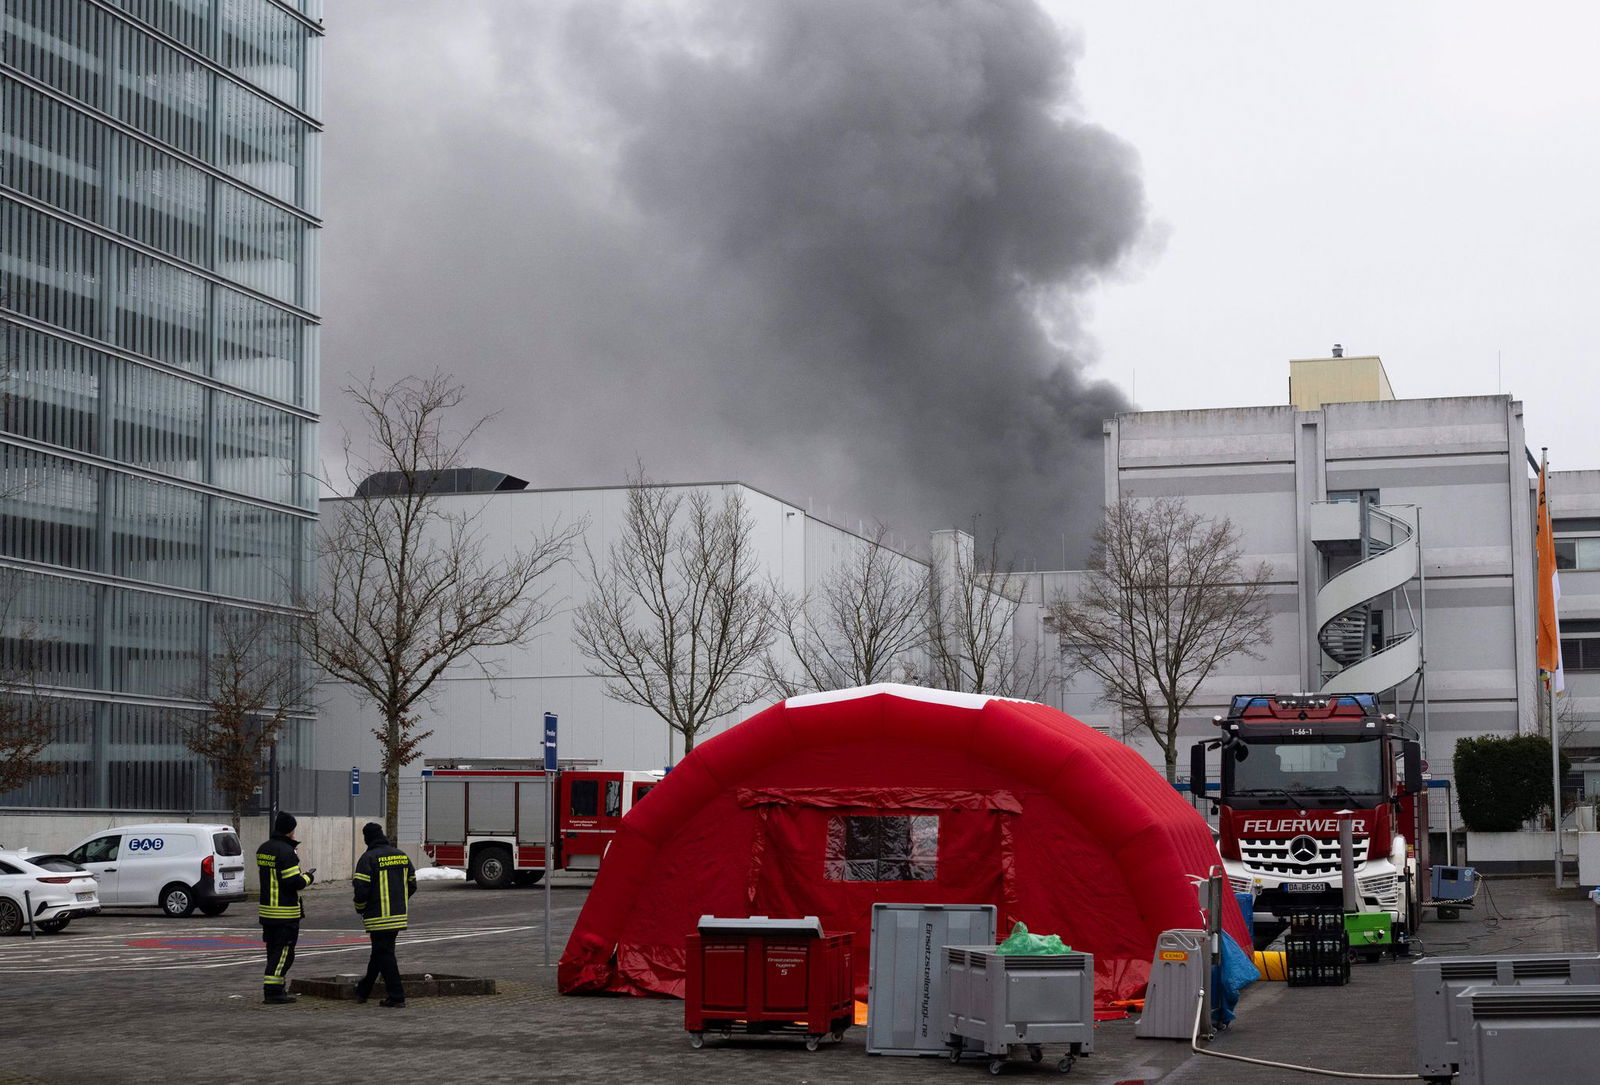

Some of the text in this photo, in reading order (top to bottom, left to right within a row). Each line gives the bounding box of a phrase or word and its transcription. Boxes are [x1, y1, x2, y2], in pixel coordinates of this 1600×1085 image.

[1291, 728, 1312, 736] 1-66-1
[1243, 819, 1366, 833] FEUERWER
[130, 839, 163, 850] EAB
[922, 923, 933, 1038] Einsatzstellenhygine
